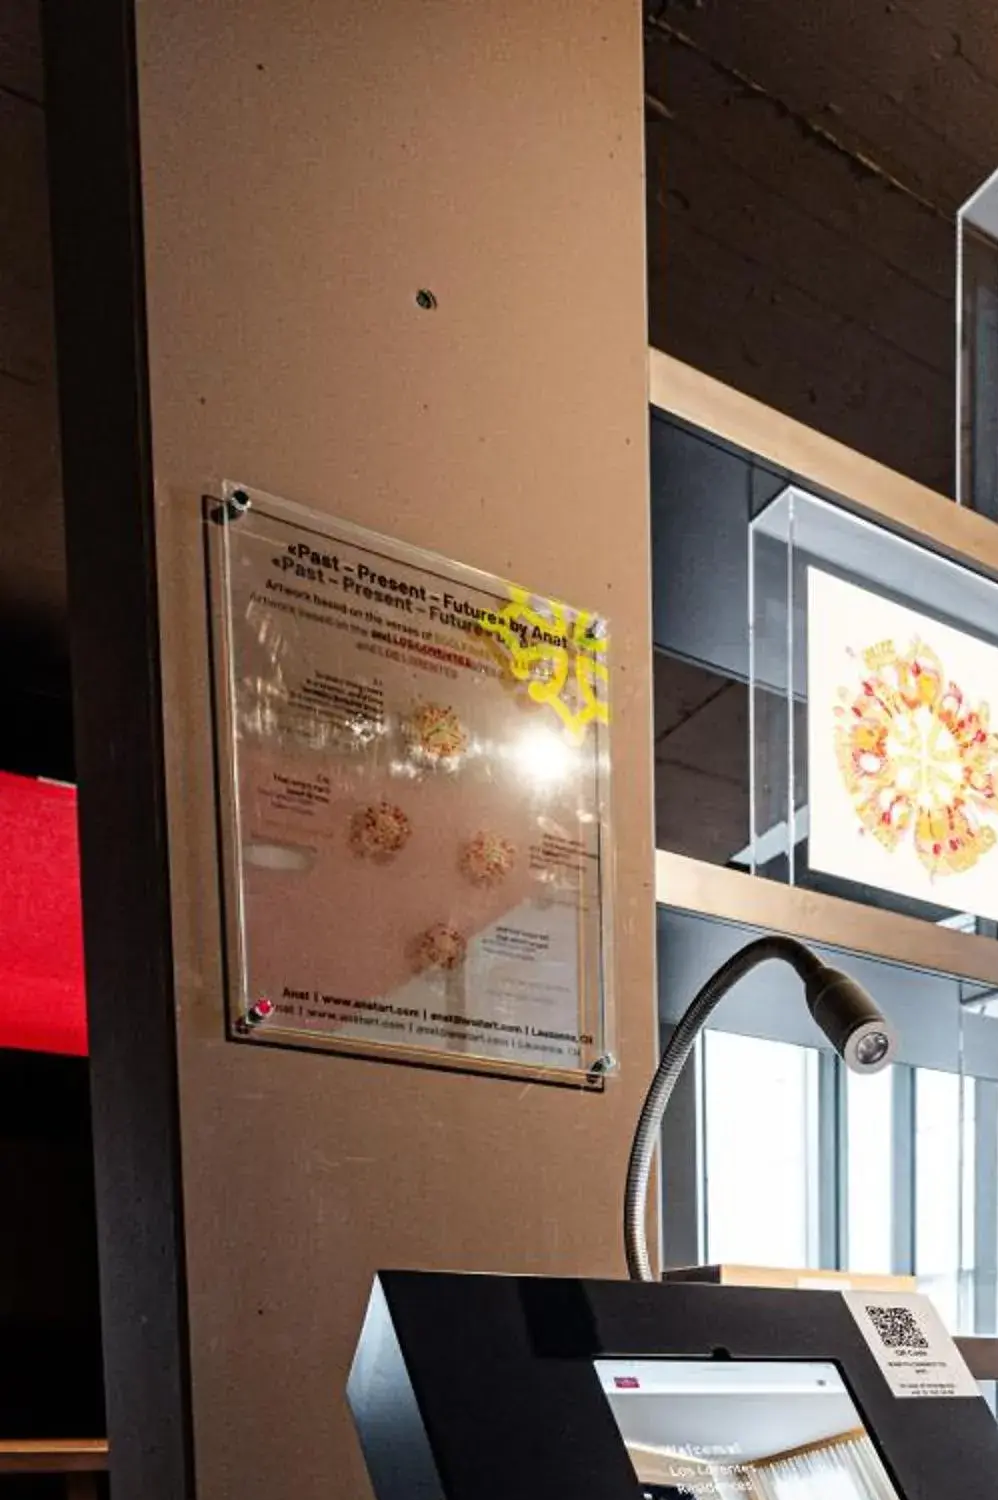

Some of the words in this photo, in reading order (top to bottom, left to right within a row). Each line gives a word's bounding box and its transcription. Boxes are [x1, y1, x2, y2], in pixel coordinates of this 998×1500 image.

[358, 563, 427, 602] Present
[510, 618, 528, 638] by
[532, 626, 568, 649] Anat
[283, 987, 309, 1000] Anat
